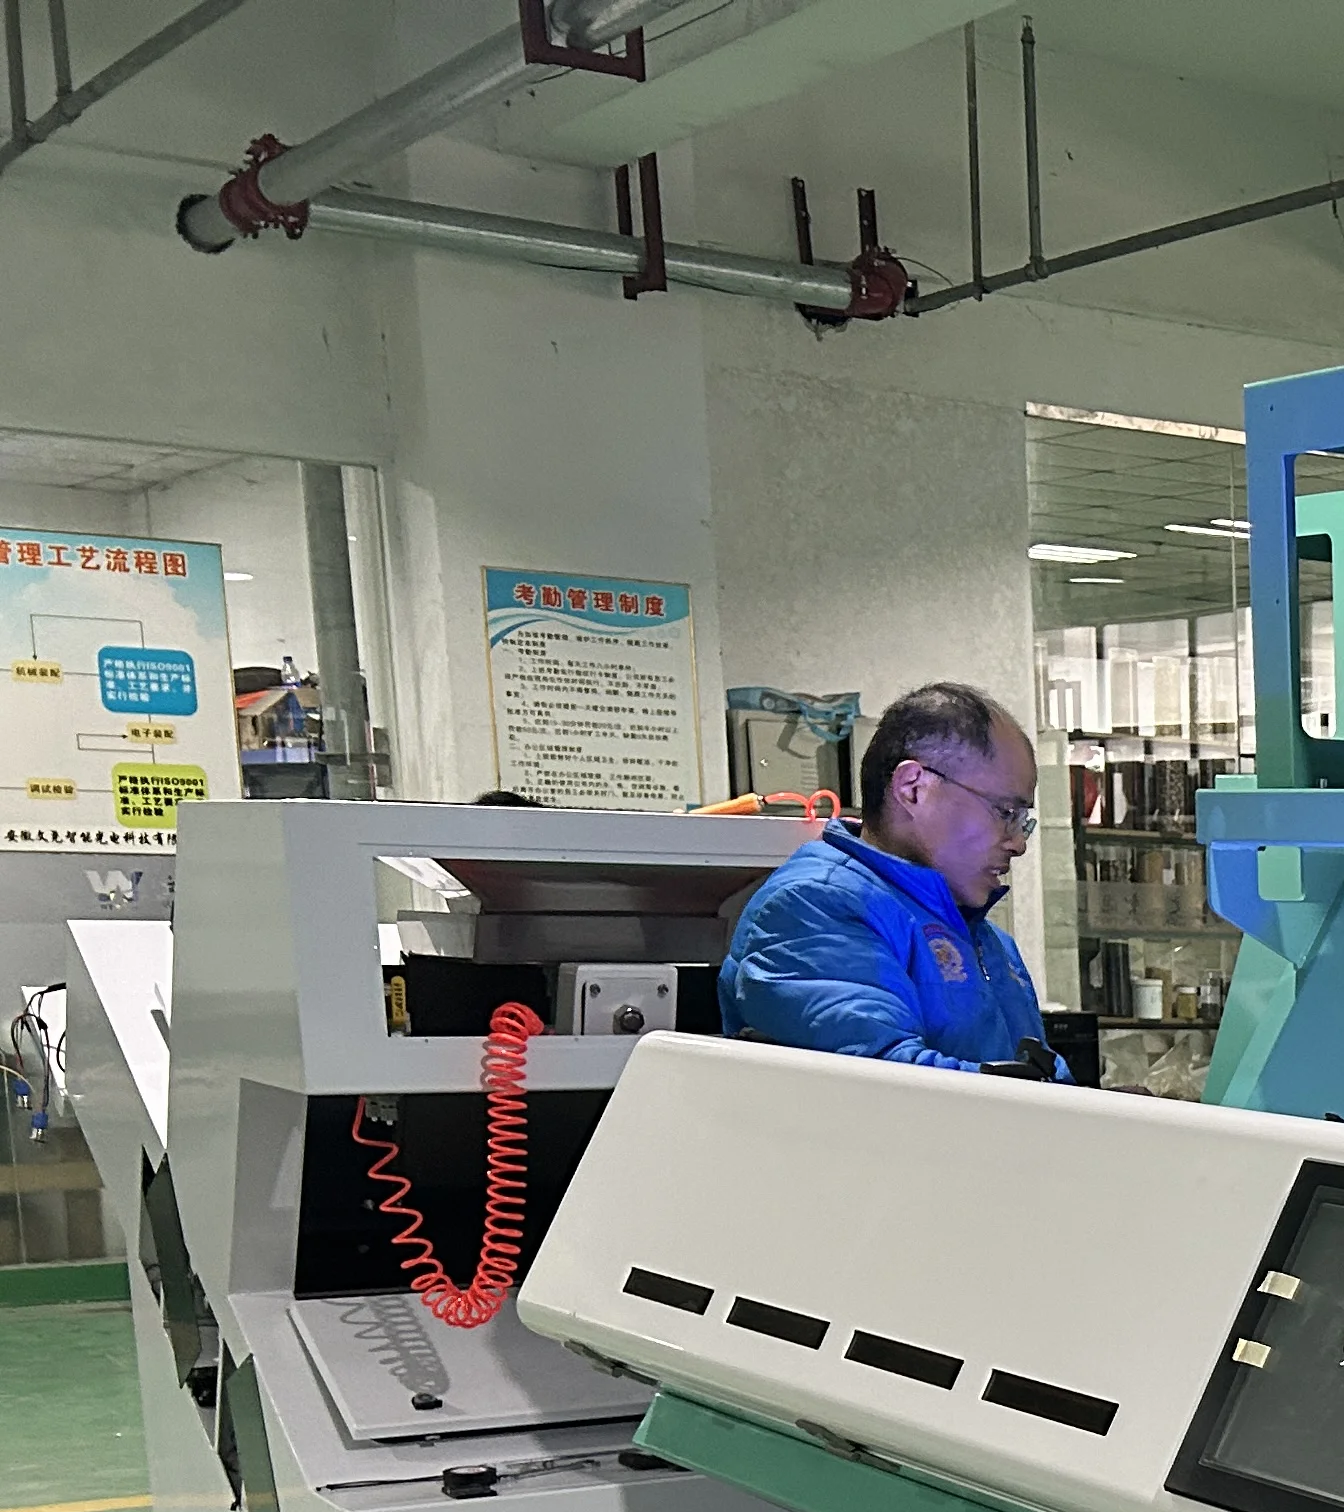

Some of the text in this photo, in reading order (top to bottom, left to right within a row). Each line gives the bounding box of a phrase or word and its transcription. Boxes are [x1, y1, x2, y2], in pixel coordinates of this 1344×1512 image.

[515, 583, 665, 617] 考勤管理制度
